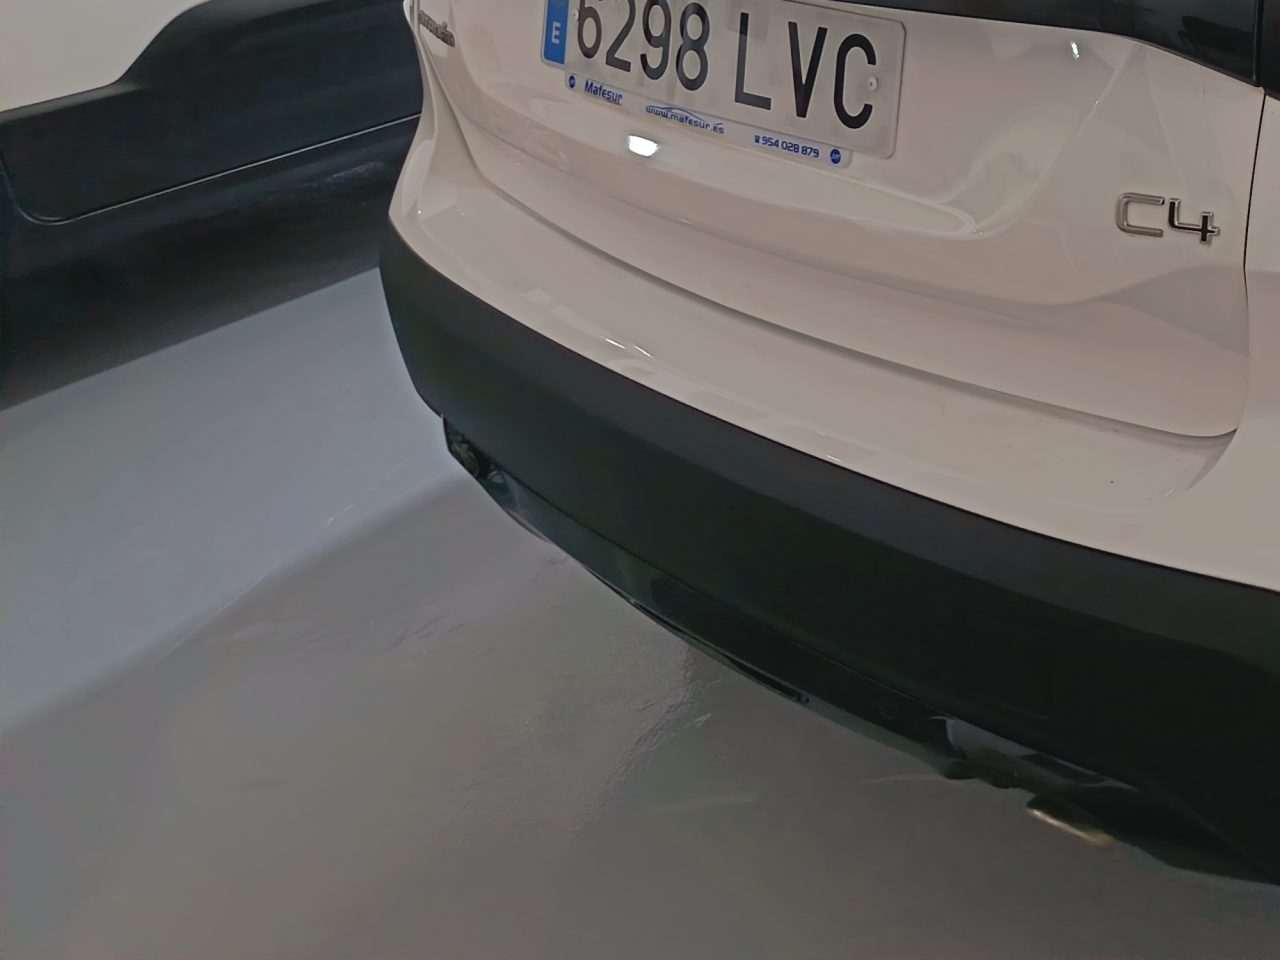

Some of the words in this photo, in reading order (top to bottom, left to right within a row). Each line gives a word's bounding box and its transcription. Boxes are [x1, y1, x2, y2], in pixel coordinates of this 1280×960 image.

[551, 20, 561, 45] E
[734, 11, 878, 130] LVC
[584, 80, 624, 105] Mafesur
[645, 105, 725, 135] www.mafesur.es
[761, 136, 780, 148] 954
[781, 140, 800, 153] 028
[801, 145, 820, 158] 879
[1115, 191, 1221, 246] C4
